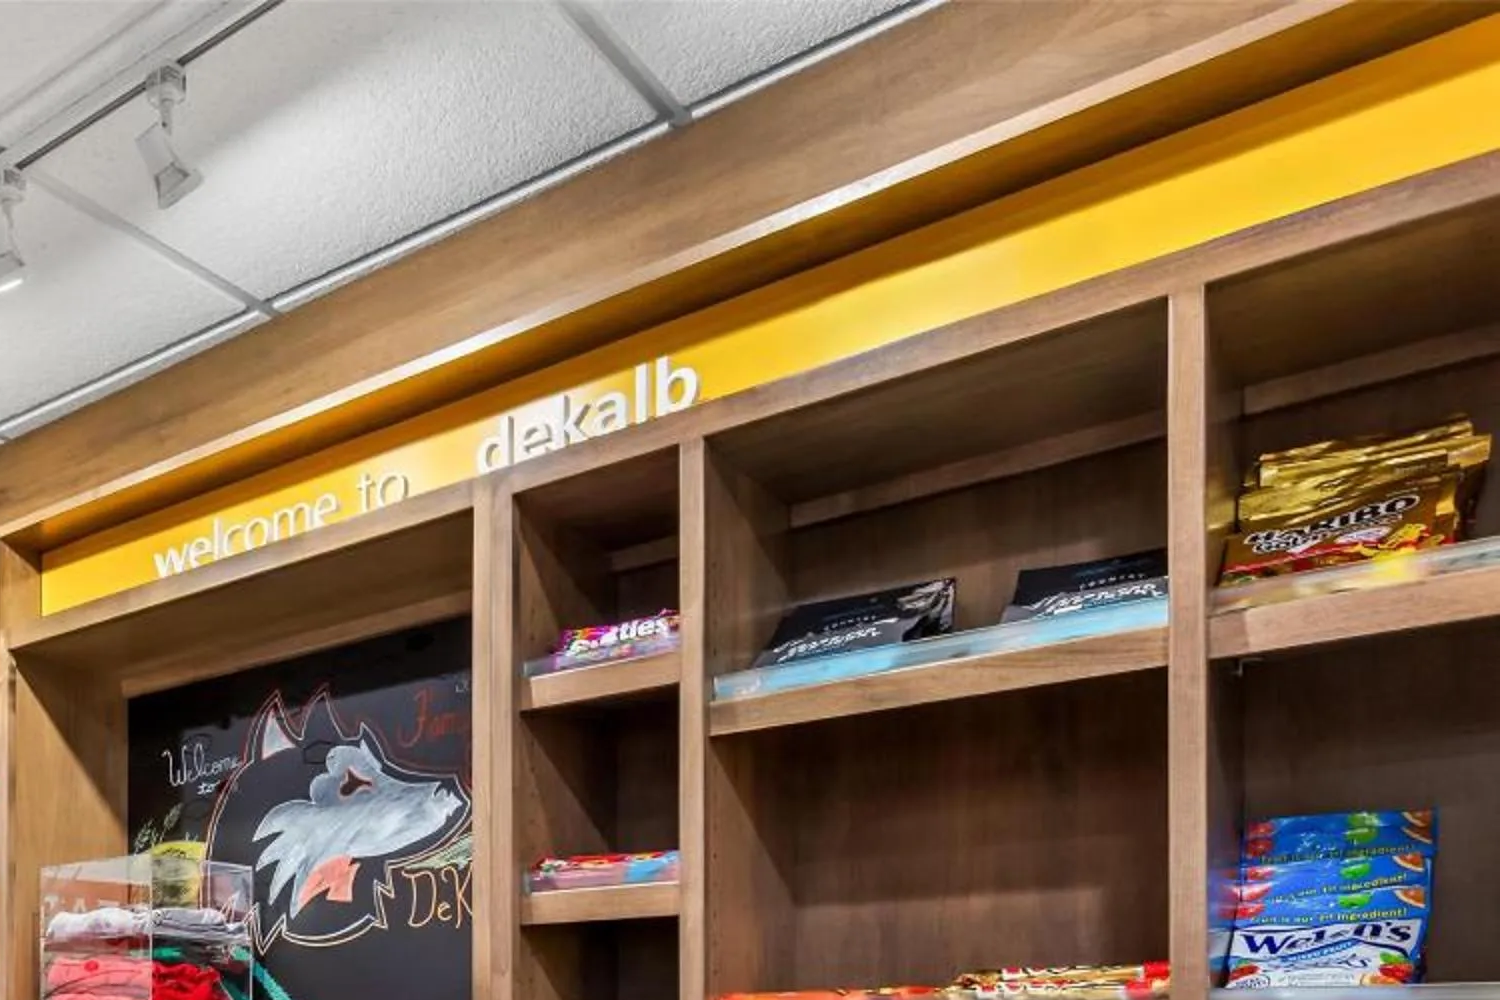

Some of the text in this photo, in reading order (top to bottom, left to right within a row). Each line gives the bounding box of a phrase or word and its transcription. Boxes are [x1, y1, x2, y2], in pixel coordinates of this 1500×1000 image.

[153, 355, 699, 578] welcome to dekalb
